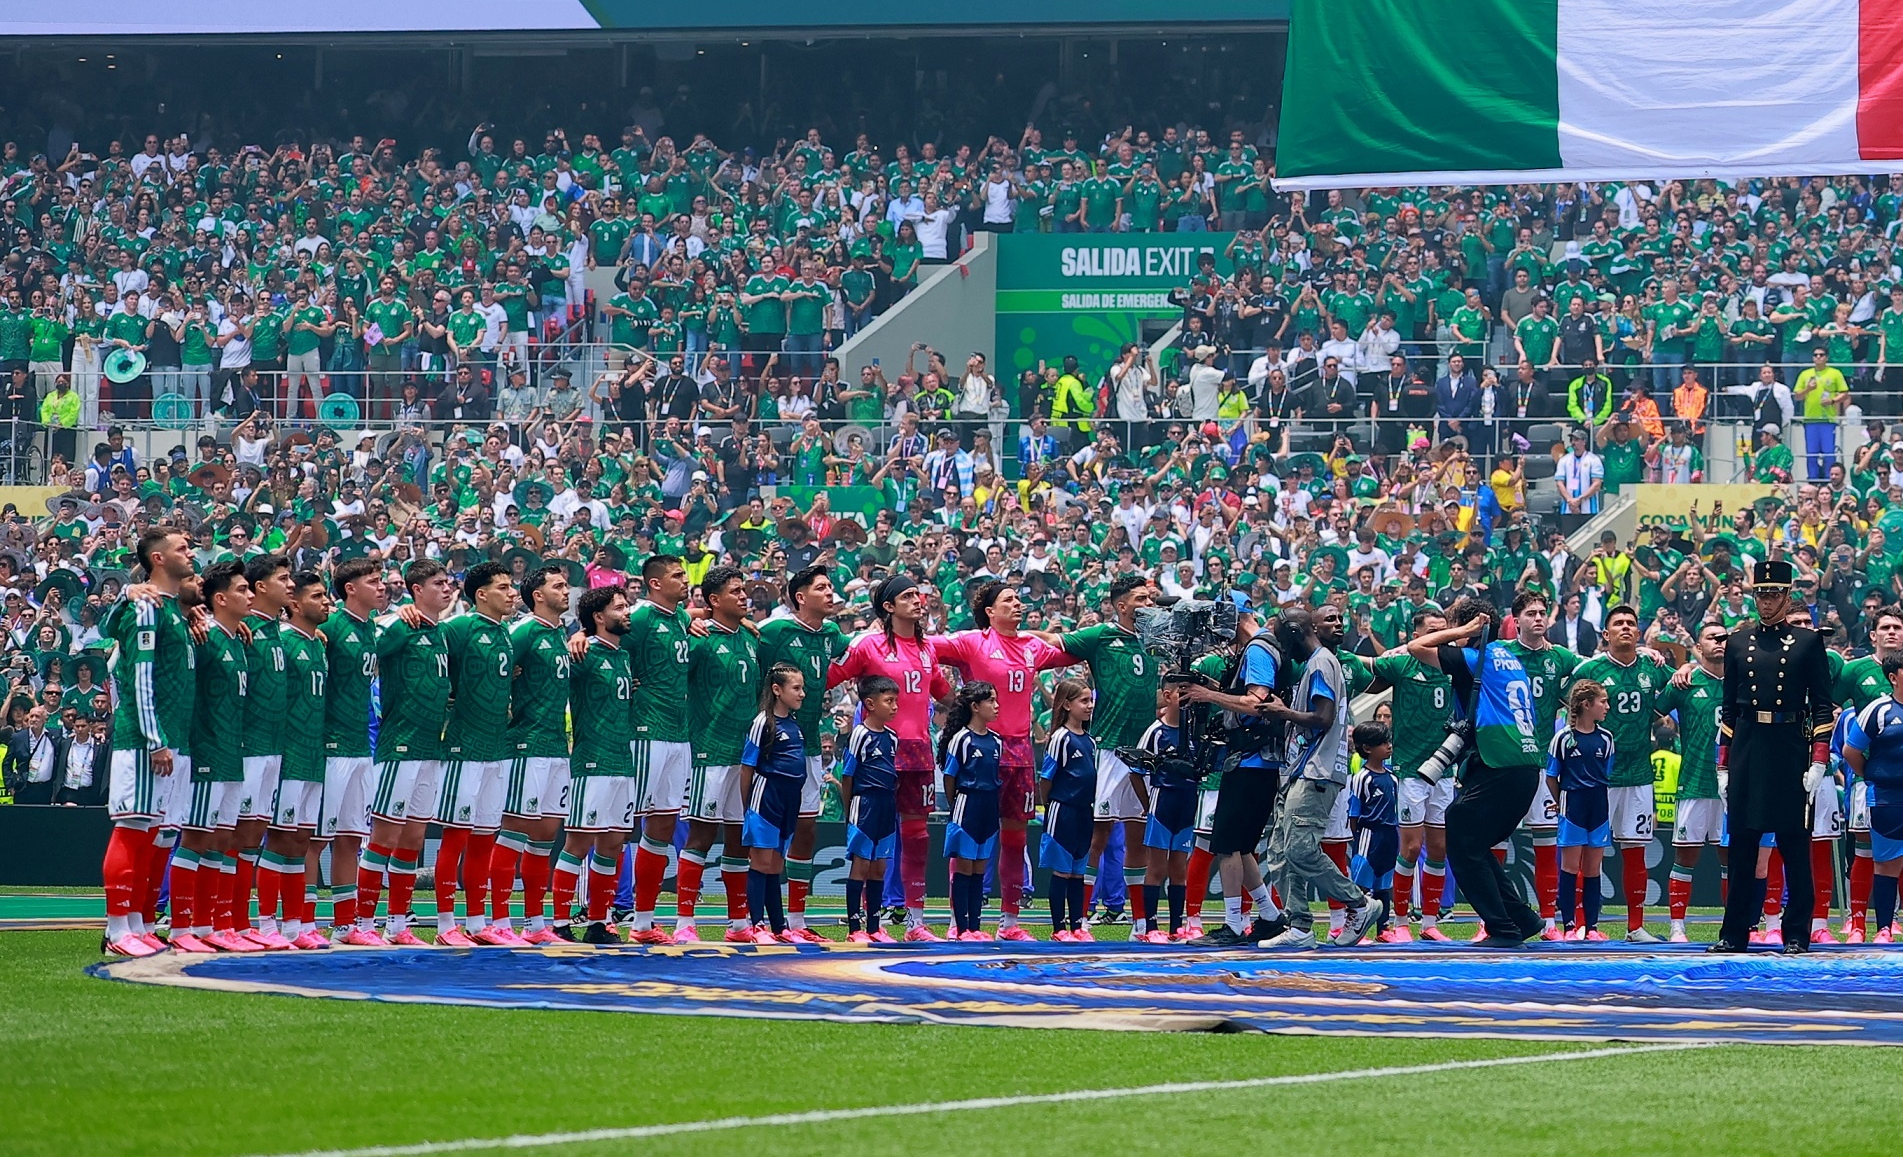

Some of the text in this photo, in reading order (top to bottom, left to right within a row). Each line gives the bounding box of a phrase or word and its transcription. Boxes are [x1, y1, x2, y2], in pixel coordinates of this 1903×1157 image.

[1062, 247, 1193, 277] SALIDA EXIT
[1062, 292, 1174, 309] SALIDA DE EMERGEN
[272, 646, 286, 672] 18
[499, 652, 508, 676] 2
[674, 640, 689, 664] 22
[435, 653, 449, 677] 14
[555, 654, 571, 679] 24
[738, 660, 748, 683] 7
[811, 655, 821, 679] 4
[1132, 654, 1143, 676] 9
[237, 670, 248, 697] 19
[312, 670, 324, 696] 17
[617, 676, 631, 700] 21
[904, 671, 922, 694] 12
[1008, 671, 1025, 693] 13
[1434, 687, 1445, 709] 8
[1617, 691, 1641, 714] 23
[921, 783, 936, 807] 12
[1655, 794, 1675, 804] RITY
